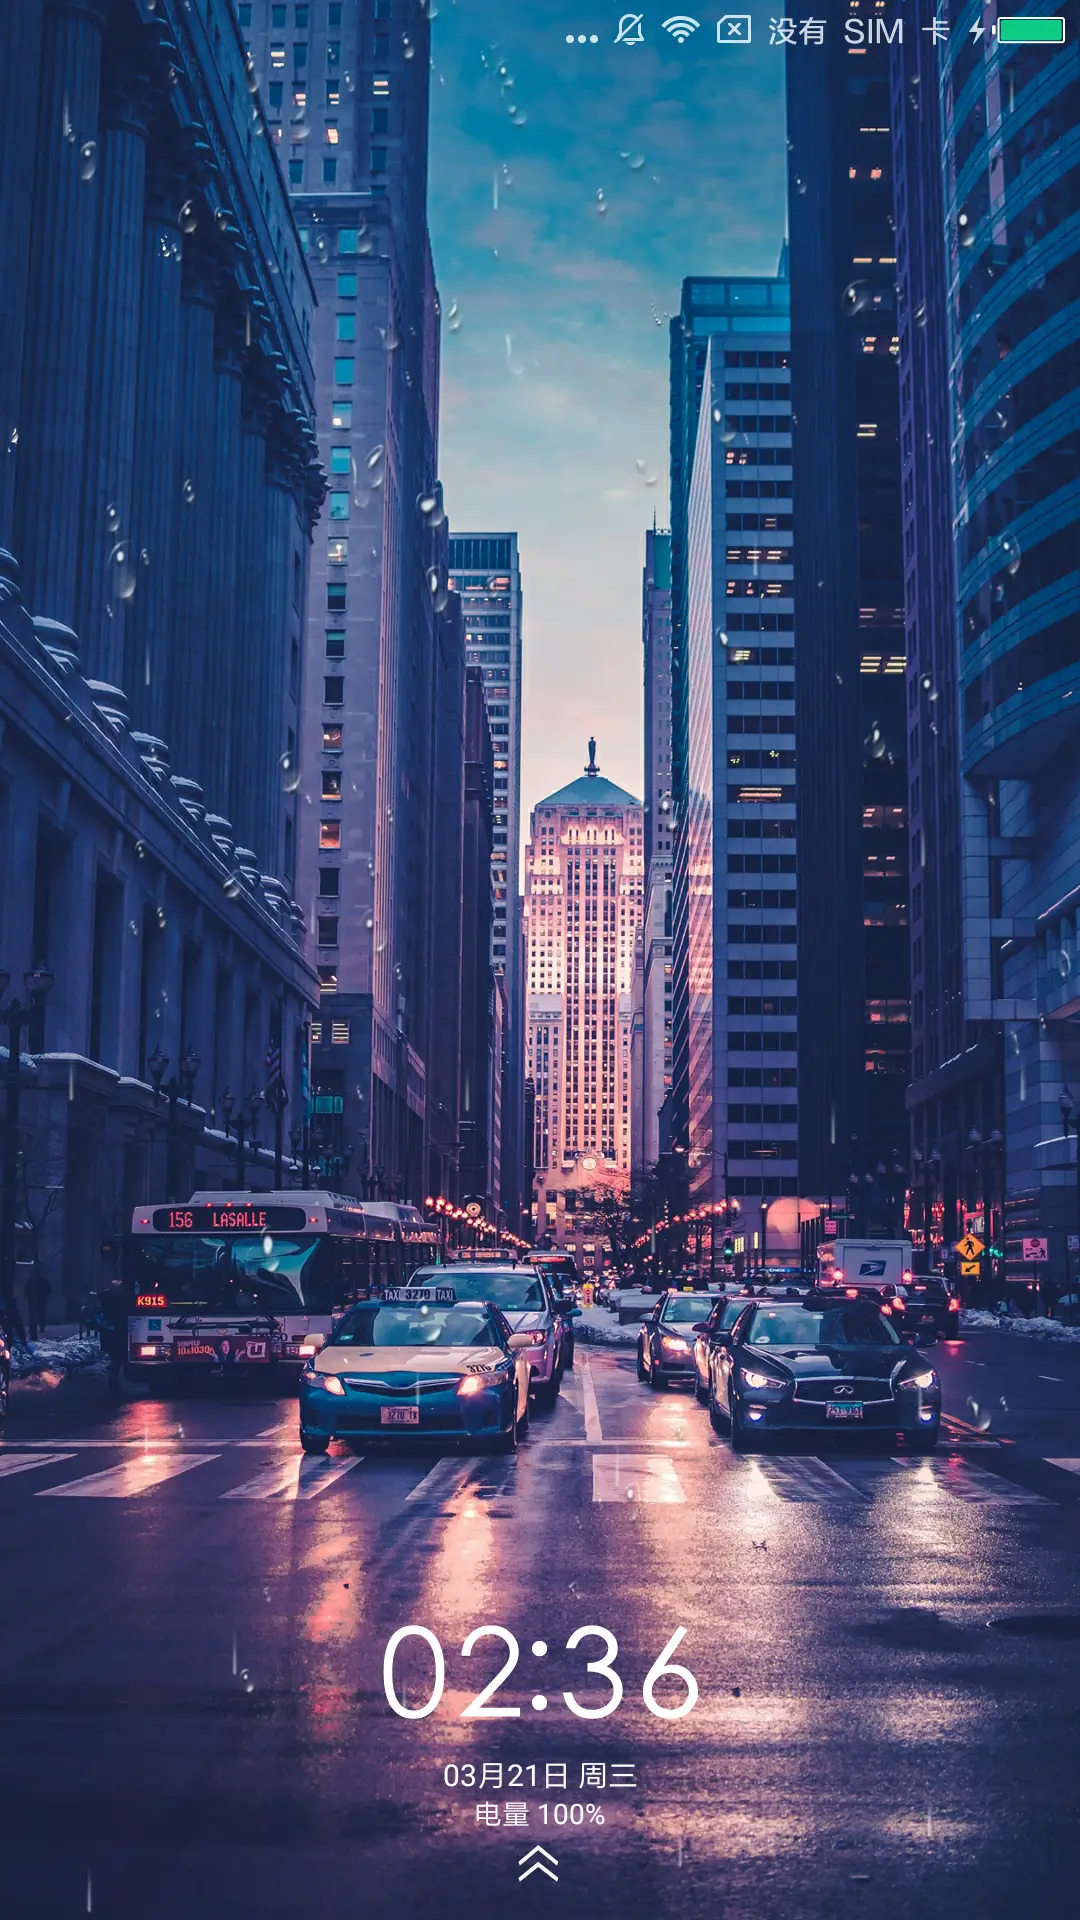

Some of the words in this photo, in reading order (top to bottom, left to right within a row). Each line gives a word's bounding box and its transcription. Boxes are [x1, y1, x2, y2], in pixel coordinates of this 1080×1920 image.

[169, 1211, 193, 1228] 156
[213, 1211, 267, 1227] LASALLE
[384, 1289, 400, 1300] TAXI
[405, 1289, 431, 1300] 3270
[436, 1289, 454, 1300] TAXI
[137, 1295, 165, 1306] K915
